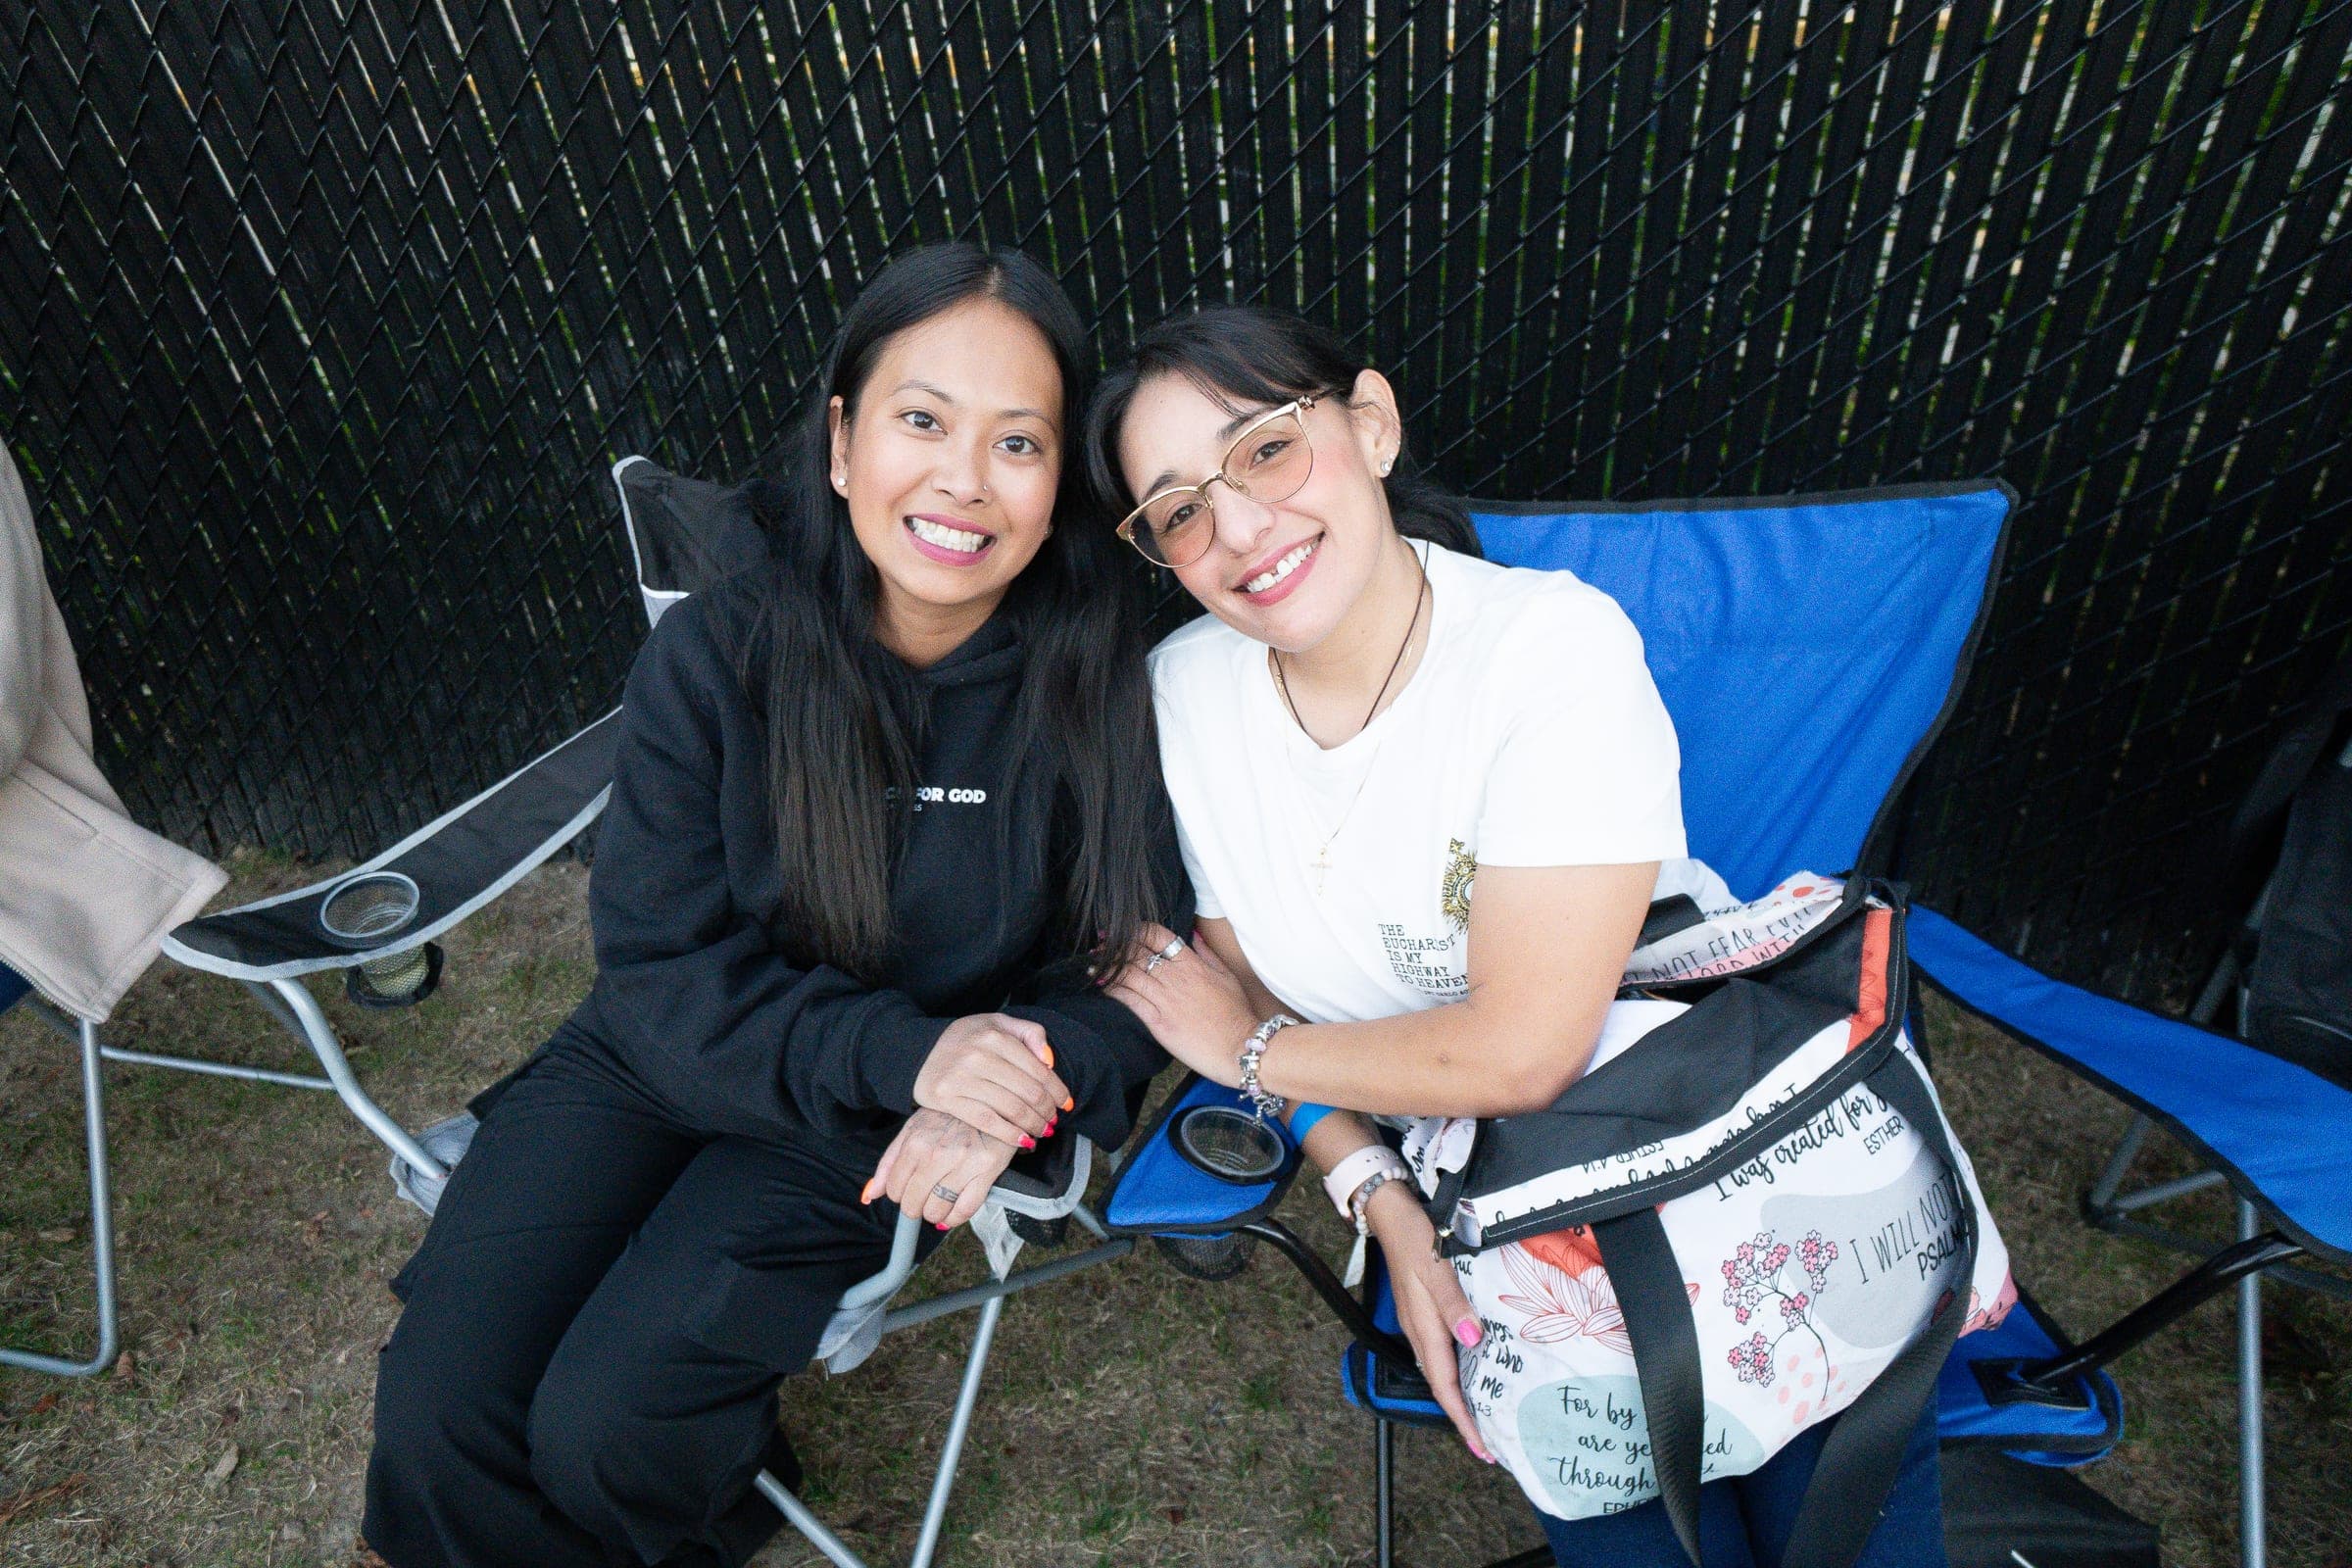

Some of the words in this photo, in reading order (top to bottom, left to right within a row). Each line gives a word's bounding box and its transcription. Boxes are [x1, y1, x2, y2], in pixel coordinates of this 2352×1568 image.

[948, 788, 987, 804] GOD
[1378, 923, 1404, 936] THE
[1383, 934, 1455, 951] EUCHARIST
[1387, 950, 1401, 960] IS
[1405, 952, 1422, 963] MY
[1392, 962, 1450, 977] HIGHWAY
[1396, 973, 1413, 985] TO
[1863, 1115, 1905, 1155] ESTHER
[1716, 1180, 1733, 1201] I
[1731, 1154, 1775, 1185] was
[1775, 1102, 1843, 1164] created
[1839, 1095, 1873, 1131] for
[1849, 1239, 1870, 1285] I
[1870, 1210, 1920, 1273] WILL
[1919, 1173, 1955, 1235] NOT
[1495, 1345, 1523, 1373] who
[1481, 1375, 1504, 1400] me
[1556, 1385, 1598, 1419] For
[1607, 1392, 1637, 1431] by
[1578, 1434, 1616, 1453] are
[1547, 1455, 1656, 1497] through
